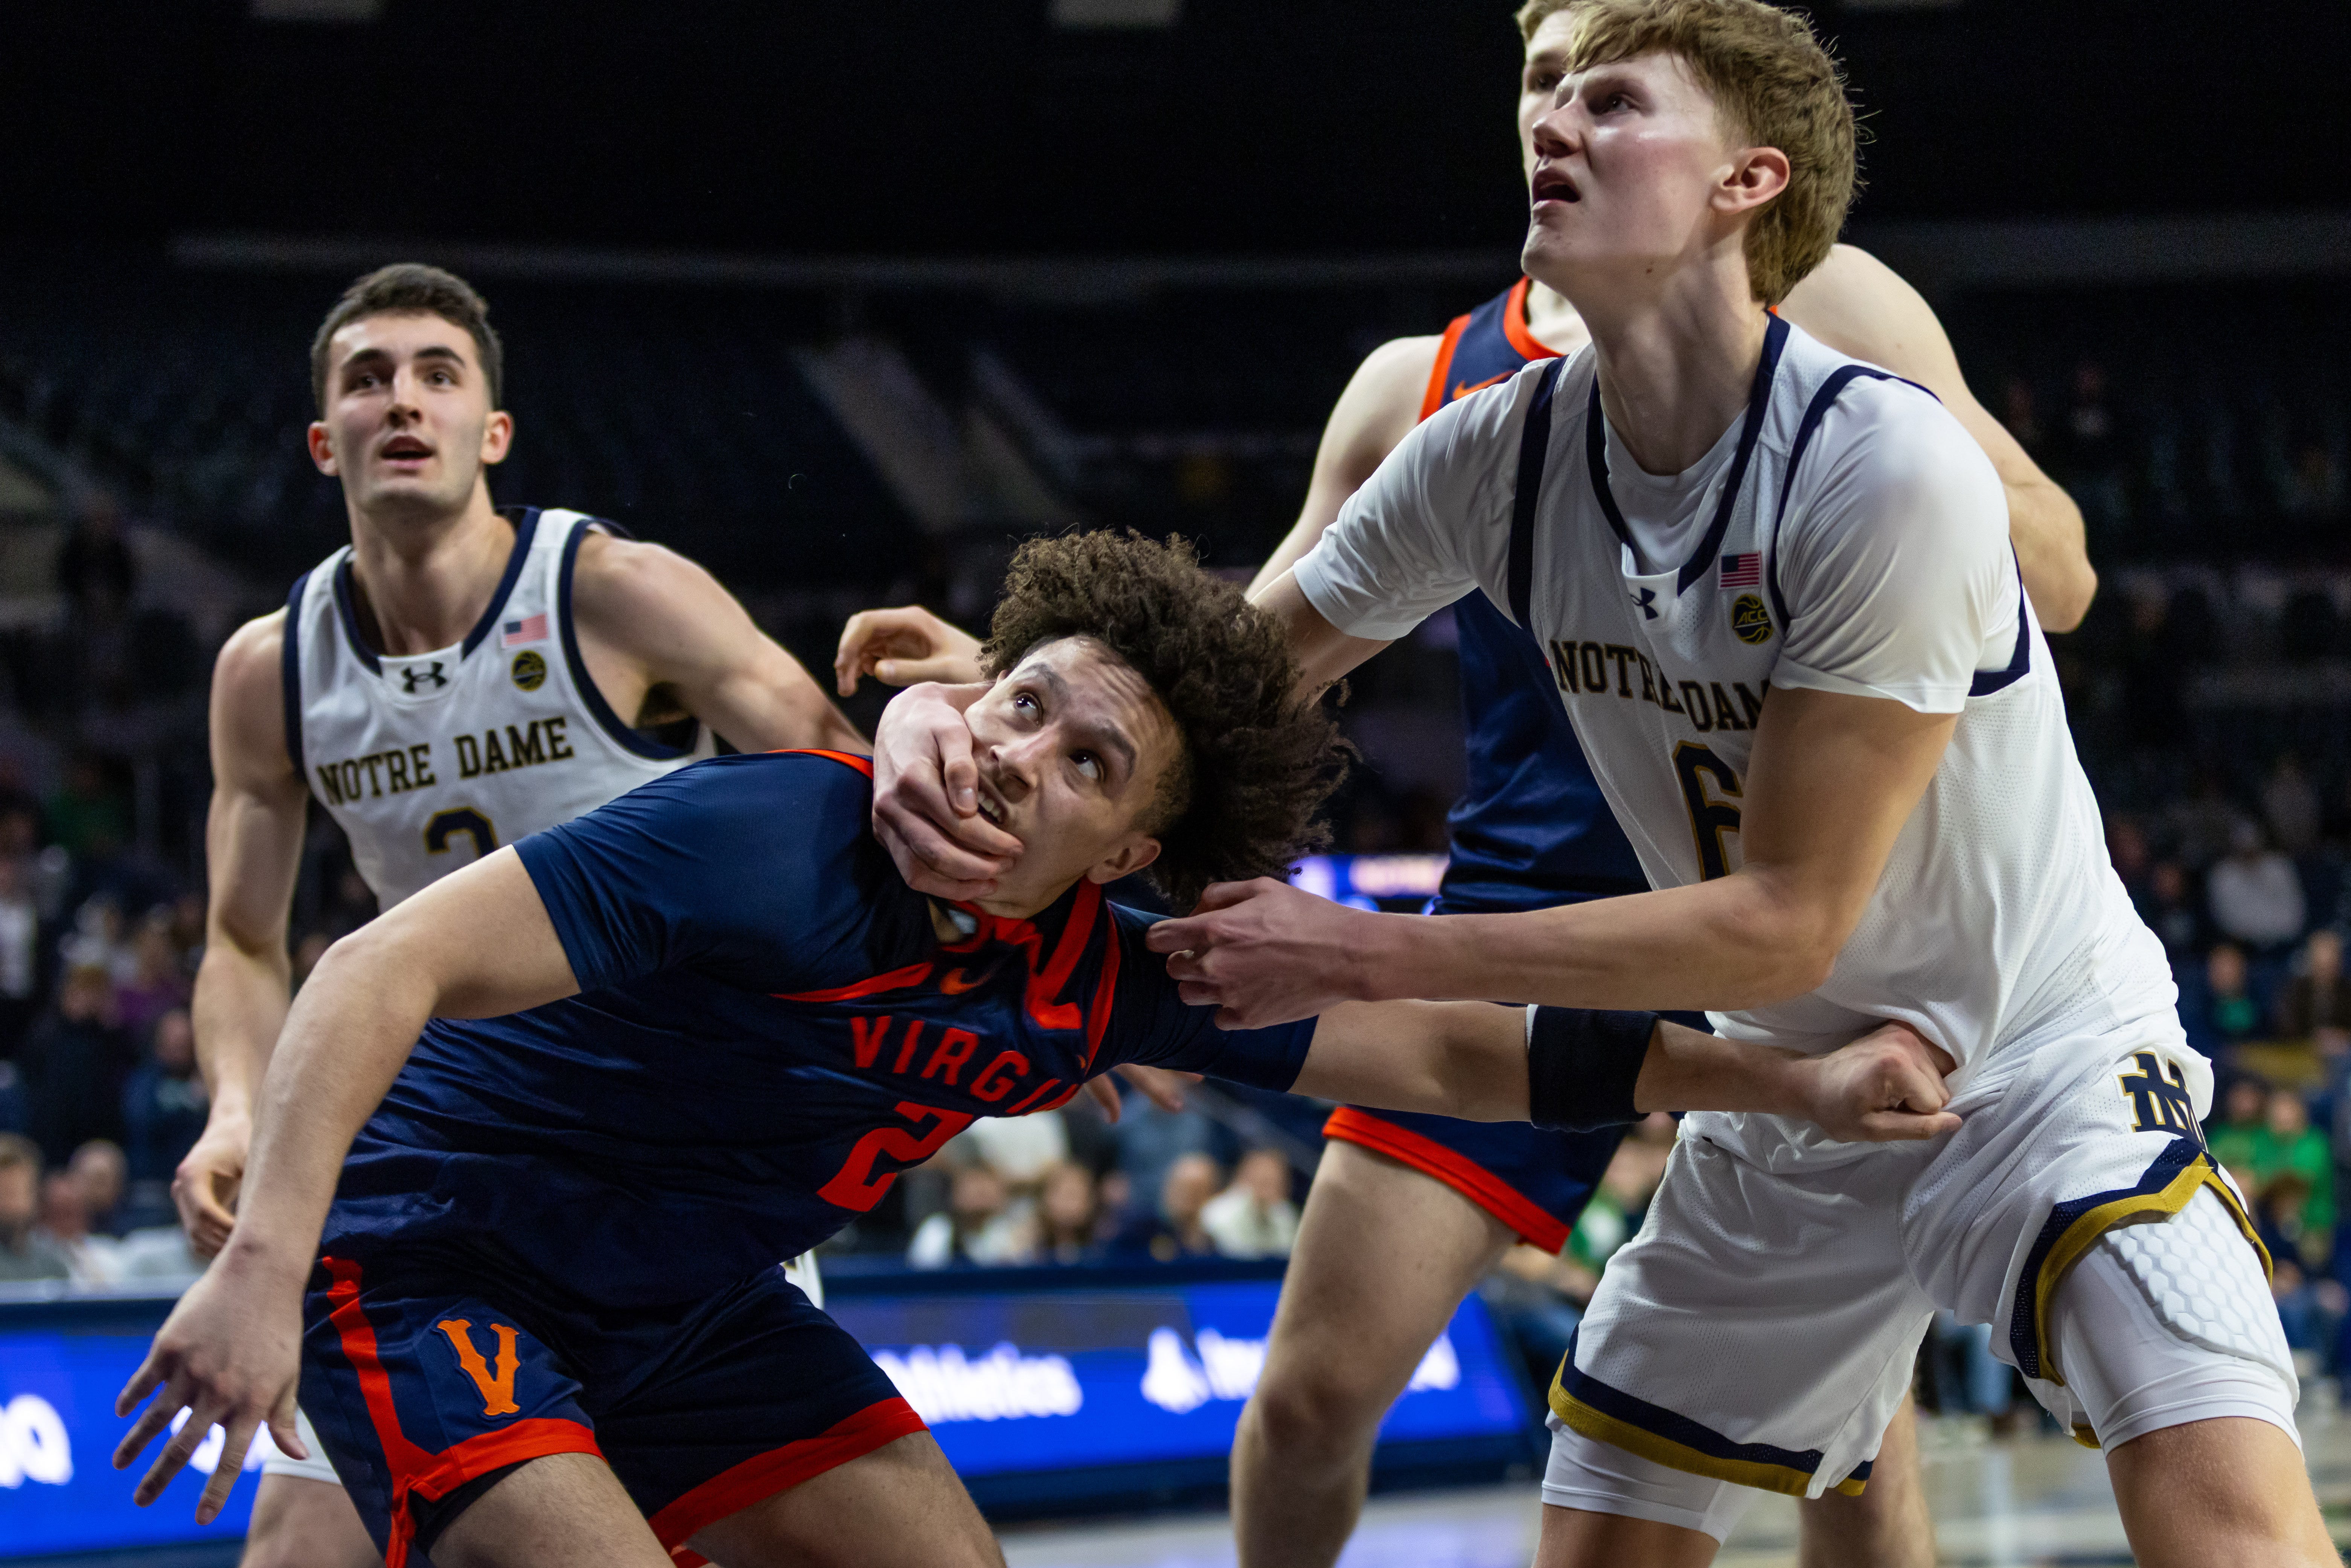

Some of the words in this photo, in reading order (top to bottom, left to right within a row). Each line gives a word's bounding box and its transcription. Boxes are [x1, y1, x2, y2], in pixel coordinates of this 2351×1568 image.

[1736, 609, 1769, 625] ACC
[316, 744, 436, 805] NOTRE
[454, 716, 574, 779] DAME
[850, 1016, 1079, 1116] VIRGI
[816, 1100, 974, 1212] 2
[437, 1319, 520, 1416] V
